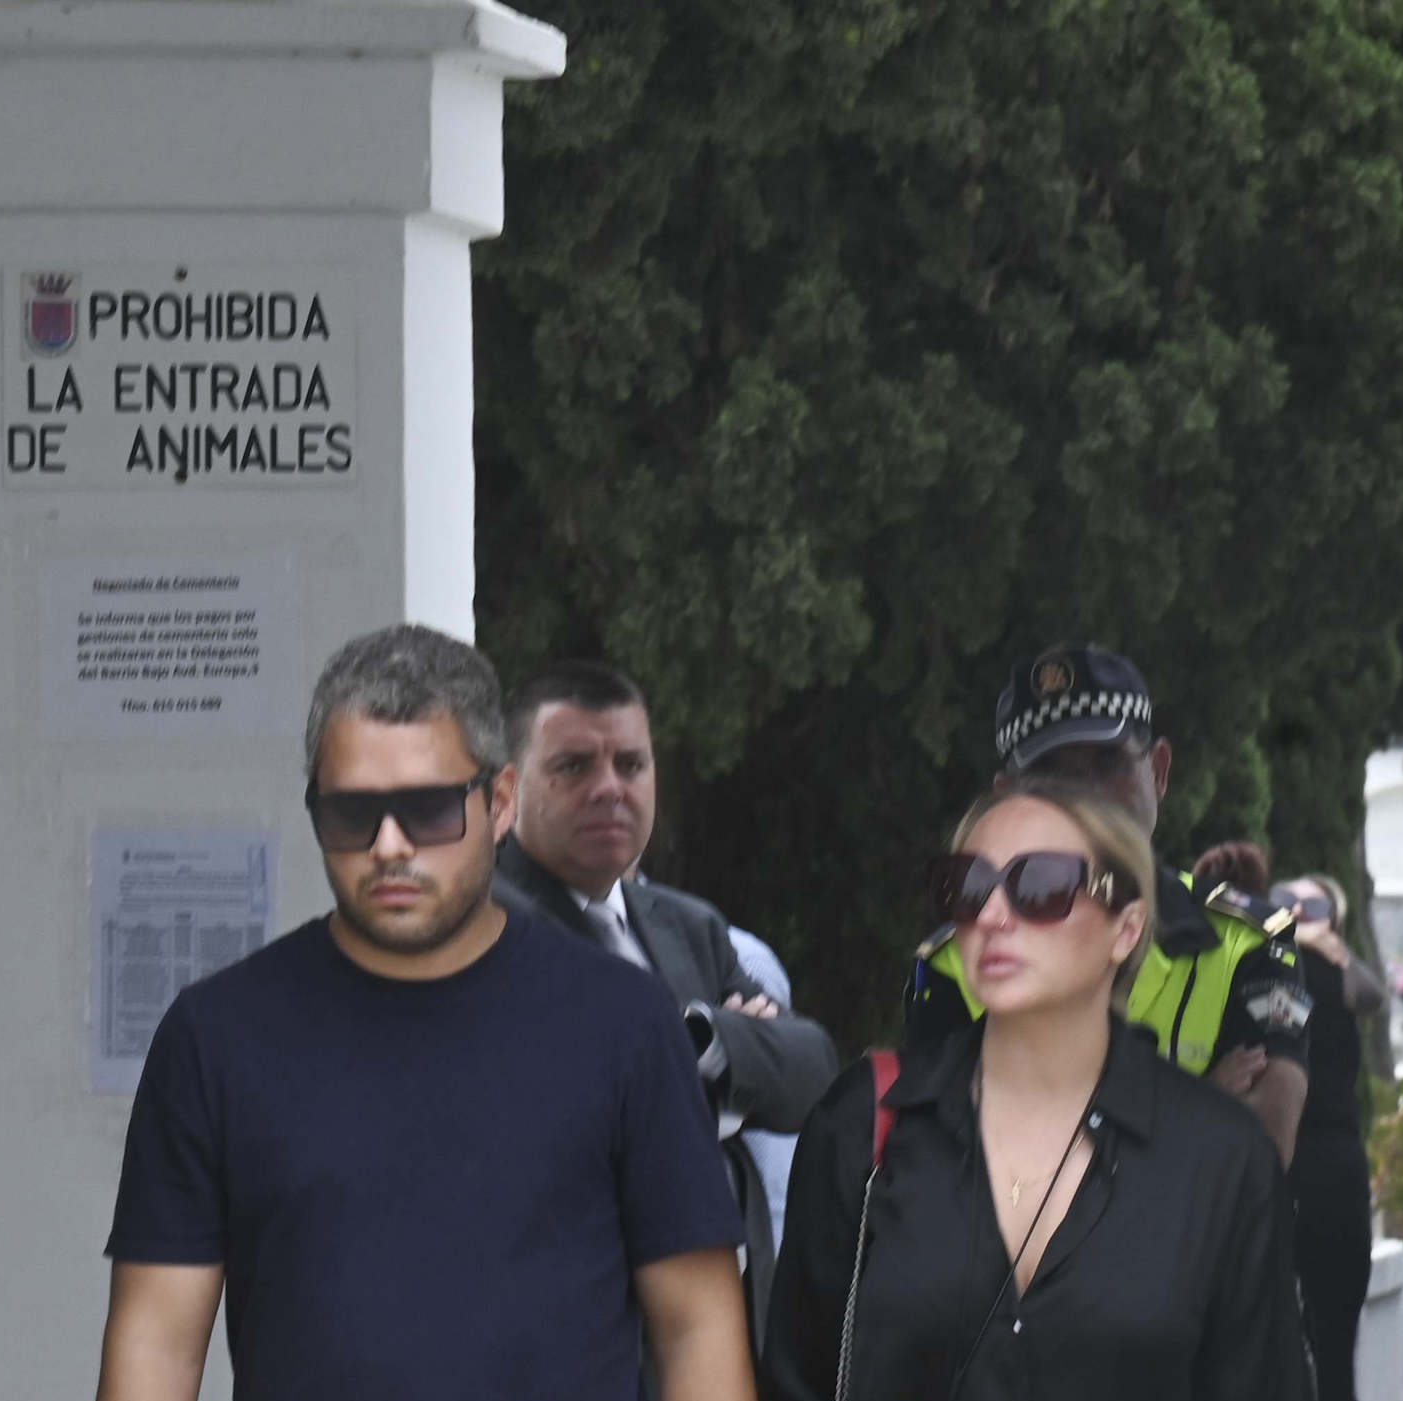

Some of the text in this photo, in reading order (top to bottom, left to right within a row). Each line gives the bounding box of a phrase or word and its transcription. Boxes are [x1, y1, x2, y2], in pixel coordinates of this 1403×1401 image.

[88, 291, 331, 342] PROHIBIDA
[27, 362, 331, 413] LA ENTRADA
[7, 423, 353, 474] DE ANIMALES
[172, 573, 240, 591] Cementerio
[96, 610, 145, 626] informa
[147, 611, 171, 627] que
[174, 608, 192, 625] los
[195, 609, 232, 627] pagos
[235, 608, 257, 625] por
[77, 630, 136, 647] gestiones
[138, 628, 156, 642] de
[157, 628, 229, 642] cementerio
[157, 648, 173, 660] en
[176, 645, 188, 659] la
[78, 665, 98, 680] del
[101, 665, 139, 680] Barrio
